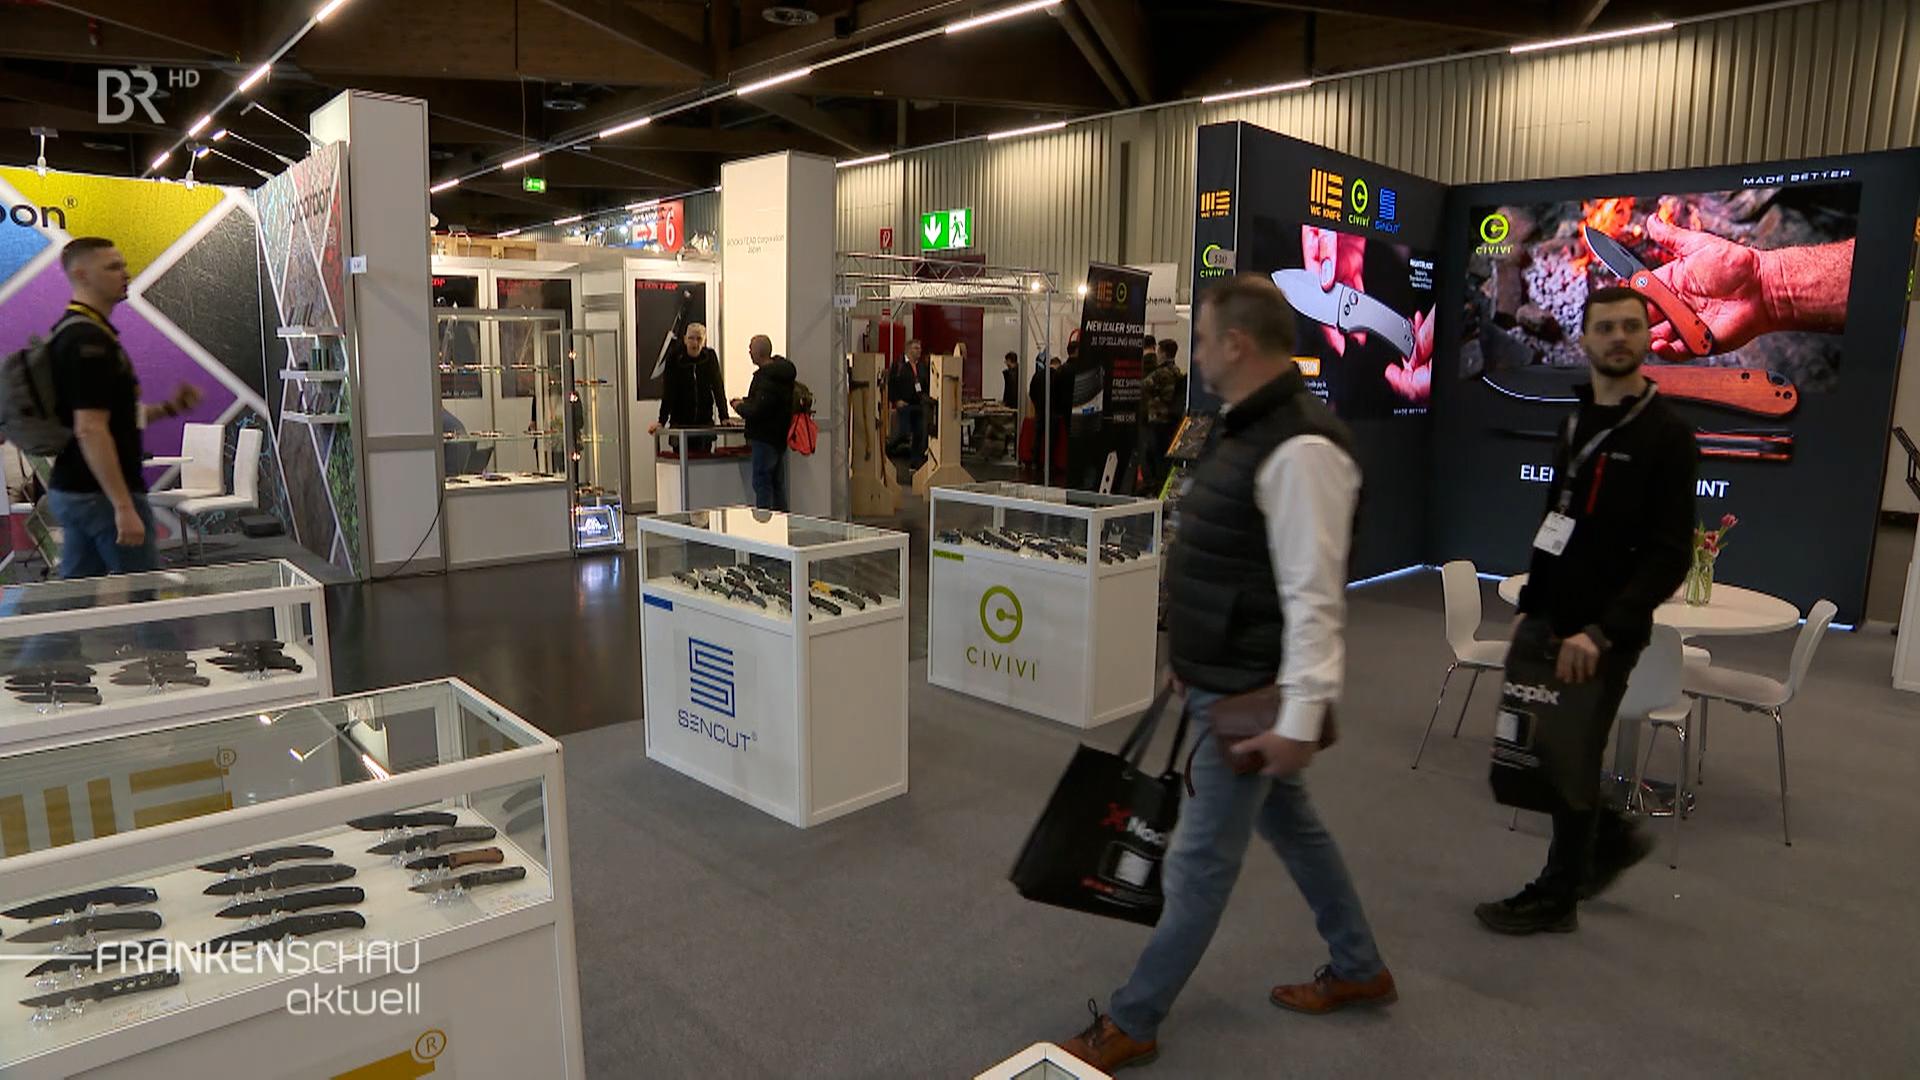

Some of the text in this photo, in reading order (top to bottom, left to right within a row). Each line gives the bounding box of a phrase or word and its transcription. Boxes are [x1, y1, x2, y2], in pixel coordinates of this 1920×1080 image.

[1743, 169, 1850, 186] MADE BETTER
[1310, 205, 1342, 222] WE KNIFE
[1348, 214, 1370, 228] CIVIVI
[665, 209, 676, 248] 6
[1475, 245, 1514, 256] CIVIVI
[1086, 320, 1102, 332] NEW
[1102, 321, 1125, 334] DEALER
[1520, 464, 1554, 483] ELE
[1695, 480, 1730, 498] INT
[966, 645, 1036, 682] CIVIVI
[1503, 681, 1560, 706] ocpix
[1126, 815, 1169, 845] Noc
